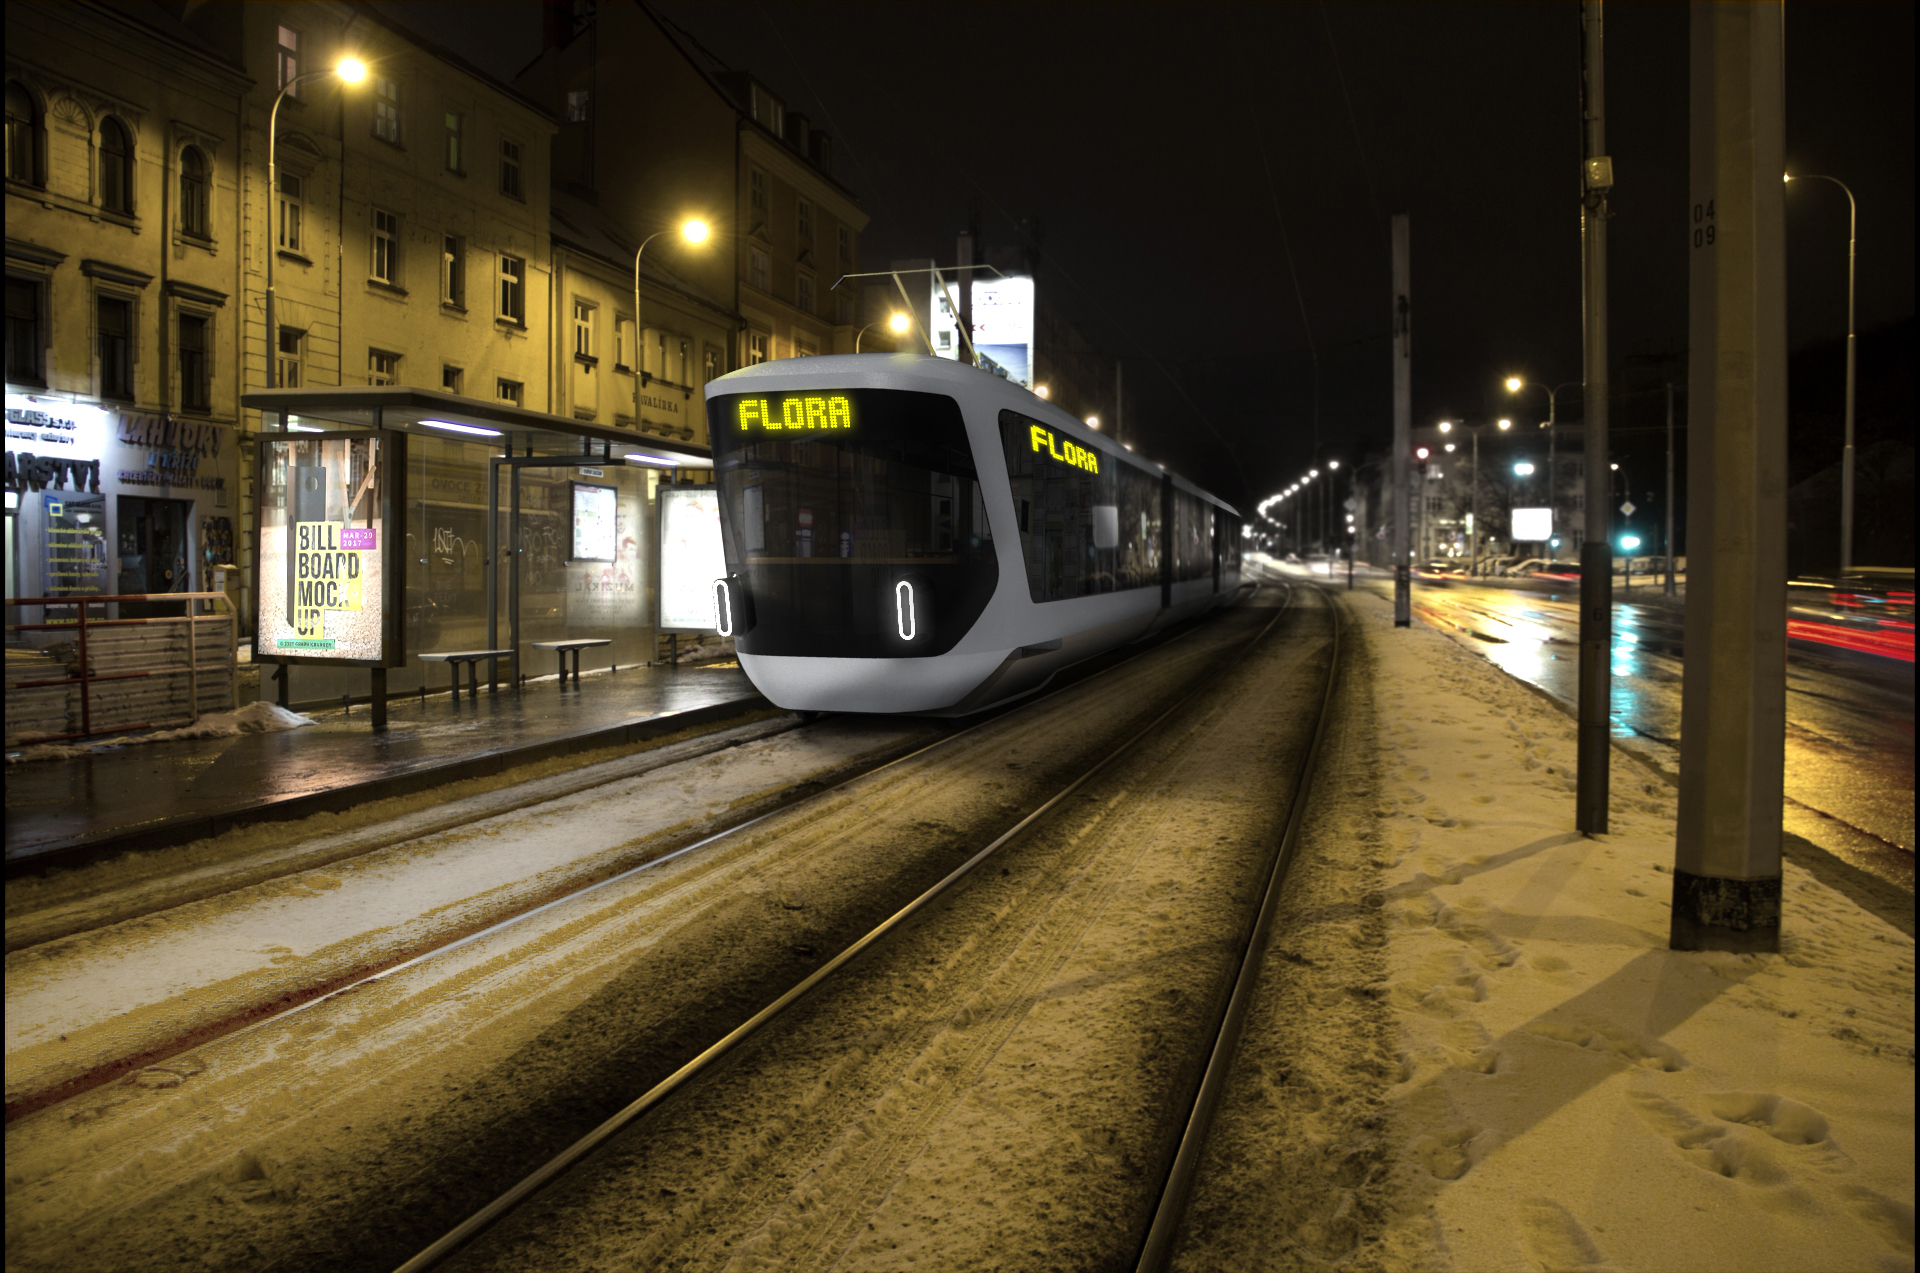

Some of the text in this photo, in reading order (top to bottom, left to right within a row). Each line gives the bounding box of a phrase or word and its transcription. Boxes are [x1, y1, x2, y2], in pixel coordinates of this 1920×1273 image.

[1693, 200, 1716, 224] 04
[1693, 225, 1716, 249] 09
[739, 397, 850, 430] FLORA
[1030, 425, 1098, 474] FLORA
[299, 525, 337, 550] BILL
[298, 552, 359, 579] BOARD
[297, 608, 321, 636] UP
